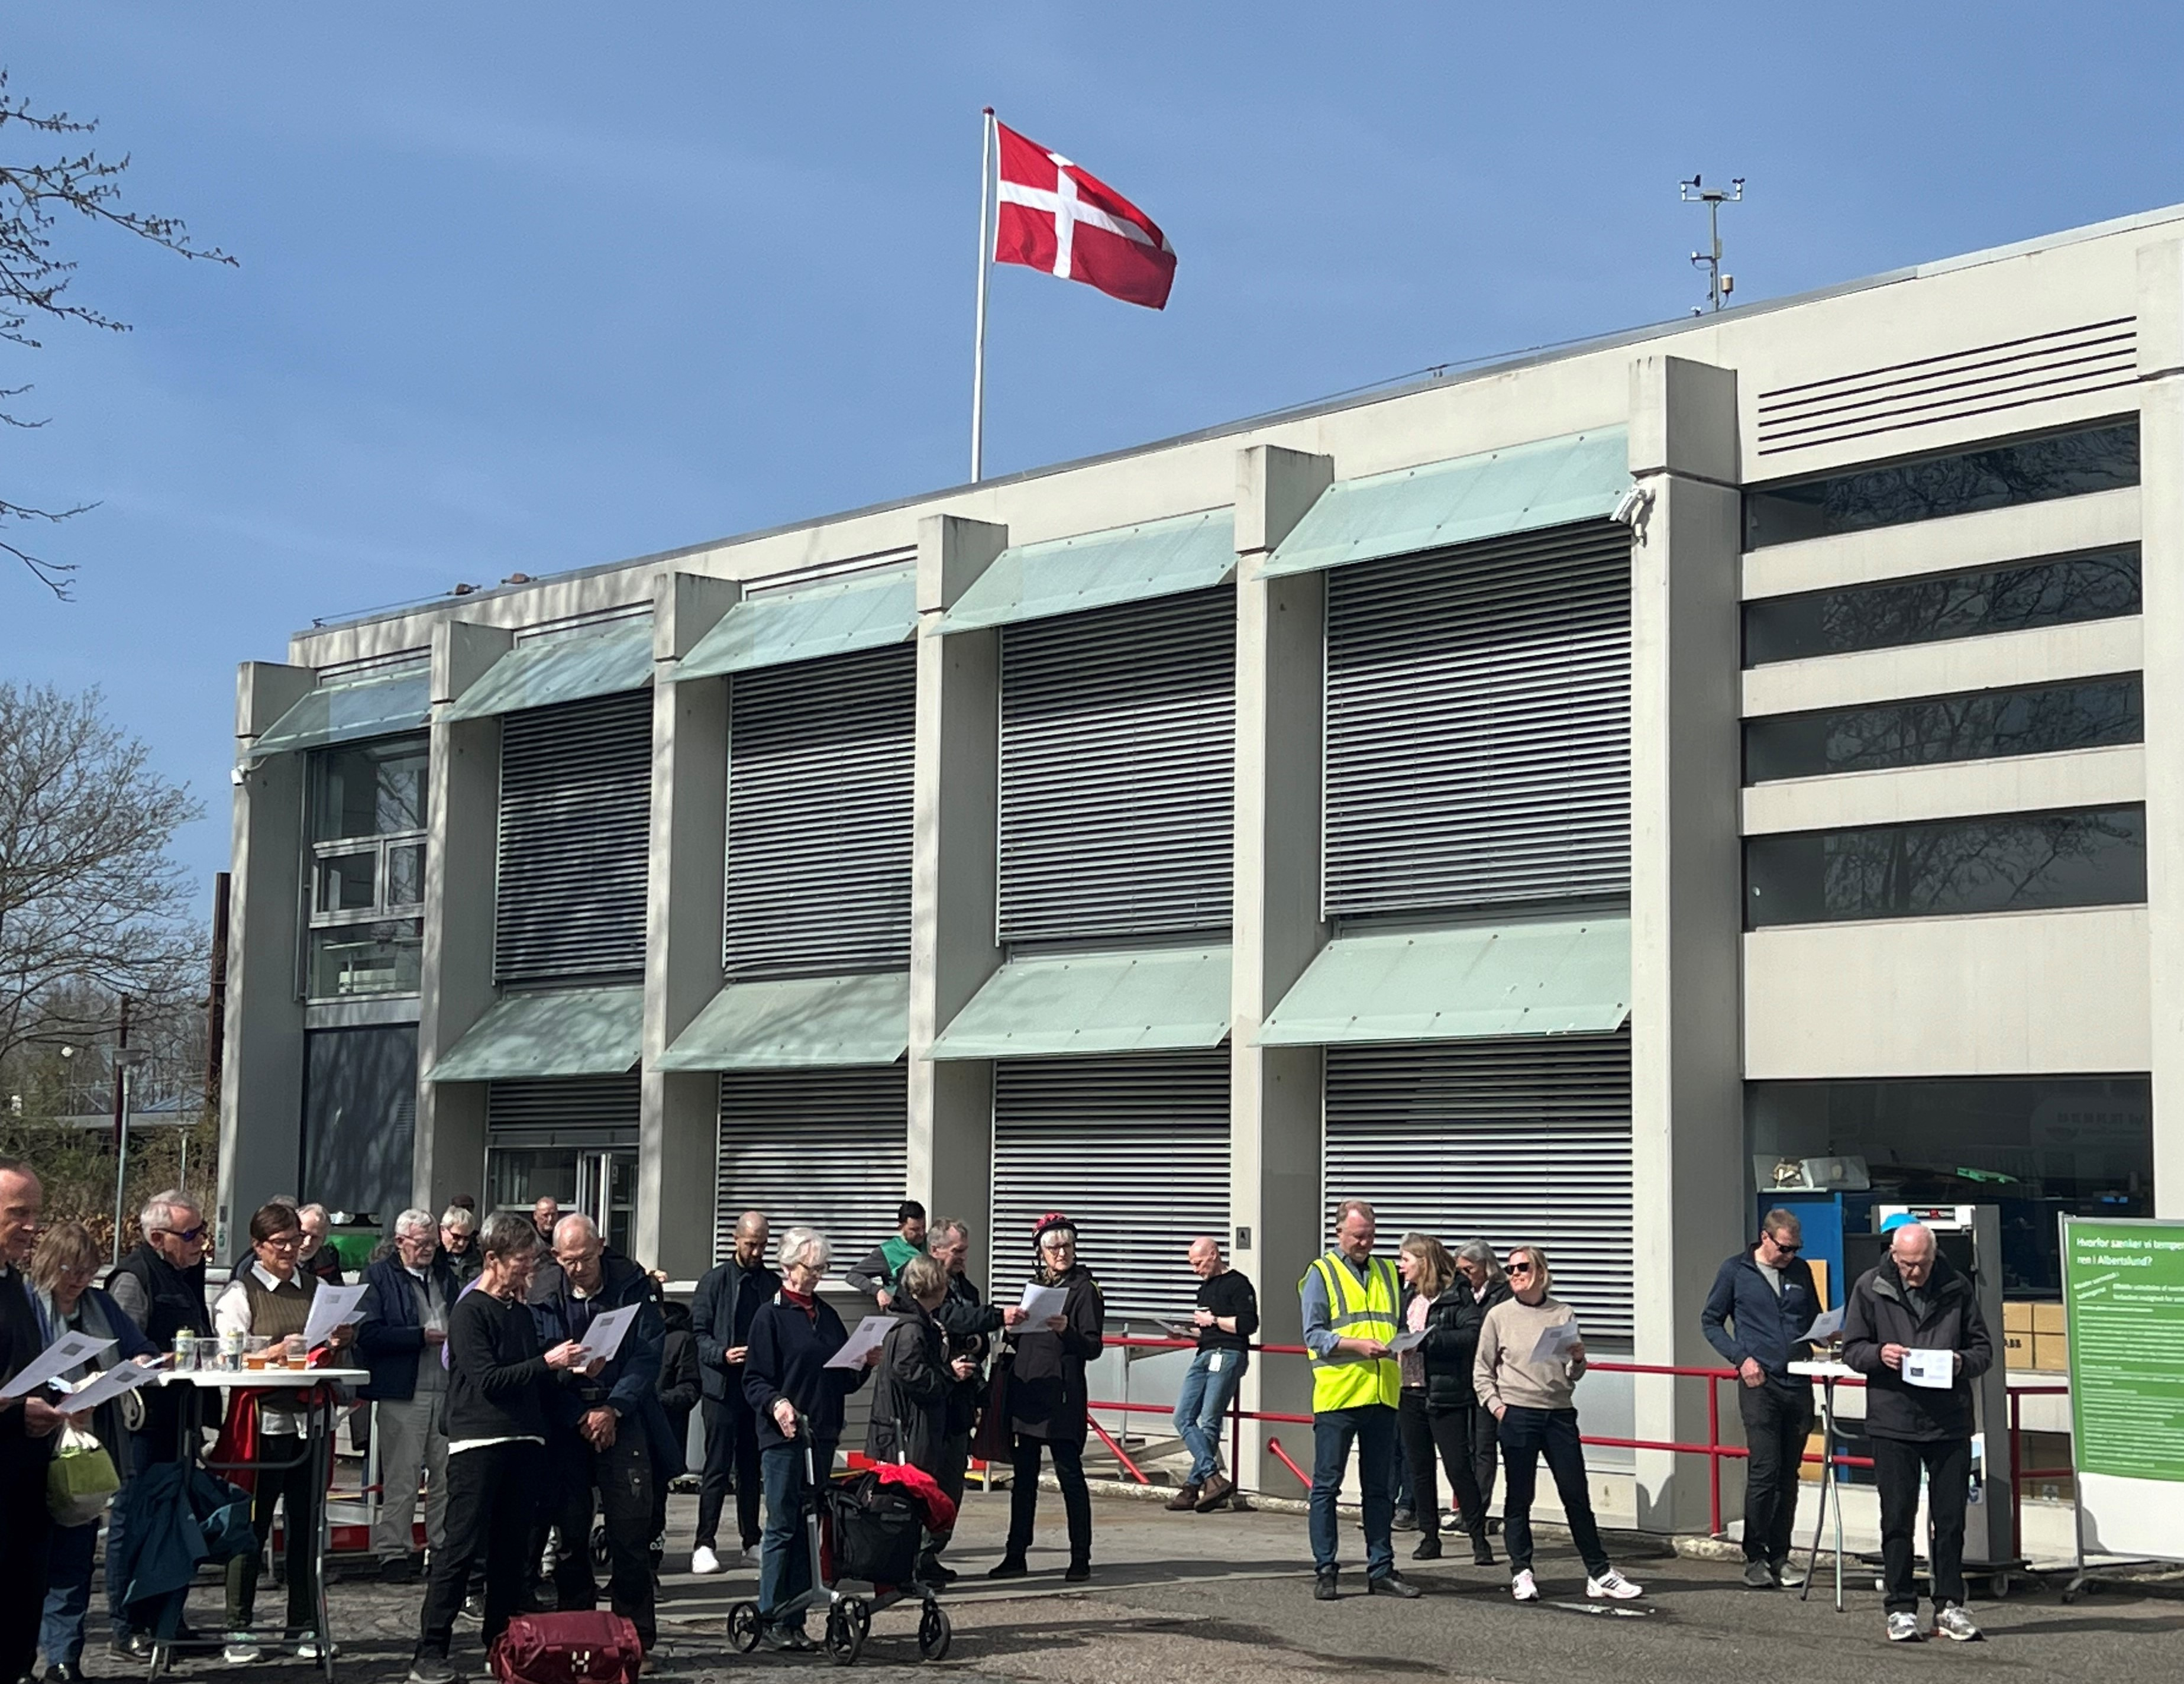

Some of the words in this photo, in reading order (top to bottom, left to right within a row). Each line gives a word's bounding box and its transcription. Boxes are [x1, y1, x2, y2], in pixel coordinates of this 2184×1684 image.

[2076, 1237, 2109, 1247] Hvorfor
[2111, 1238, 2141, 1249] sænker
[2144, 1239, 2151, 1249] vi
[2092, 1255, 2096, 1264] i
[2098, 1255, 2153, 1266] Albertslund?
